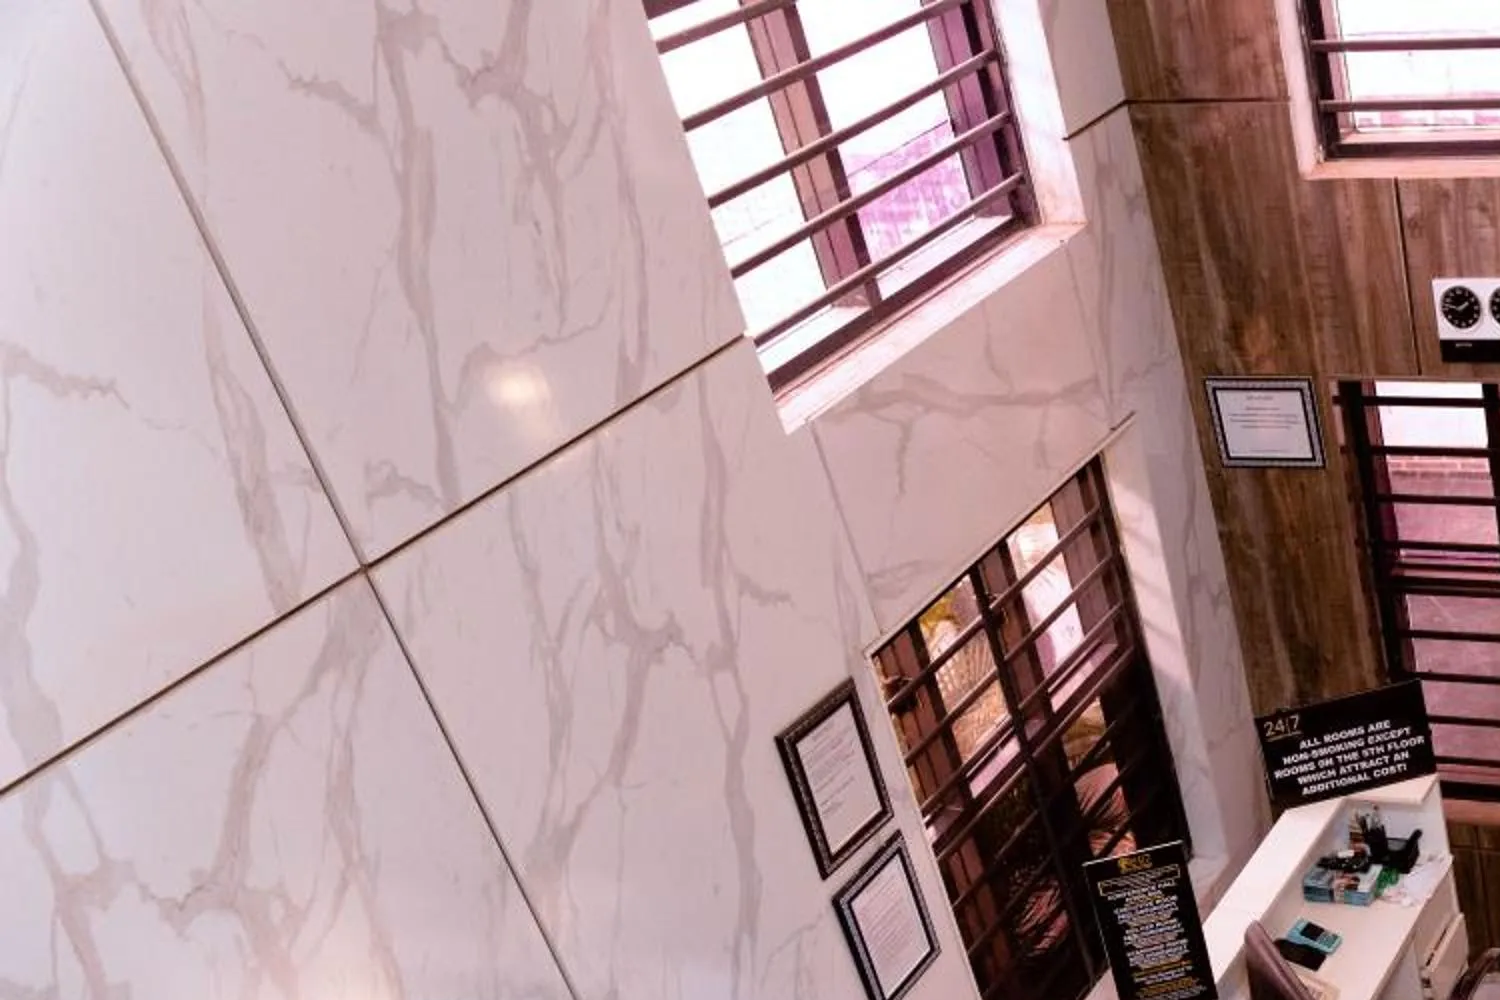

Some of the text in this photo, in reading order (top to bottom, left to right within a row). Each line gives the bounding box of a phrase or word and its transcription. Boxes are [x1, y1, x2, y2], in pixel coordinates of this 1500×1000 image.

[1282, 726, 1411, 766] NON-SMOKING EXCEPT
[1300, 719, 1391, 750] ALL ROOMS ARE
[1273, 763, 1317, 780] ROOMS
[1318, 757, 1334, 768] ON
[1336, 752, 1361, 764] THE
[1387, 735, 1425, 752] FLOOR
[1297, 751, 1410, 786] WHICH ATTRACT AN
[1301, 773, 1371, 796] ADDITIONAL
